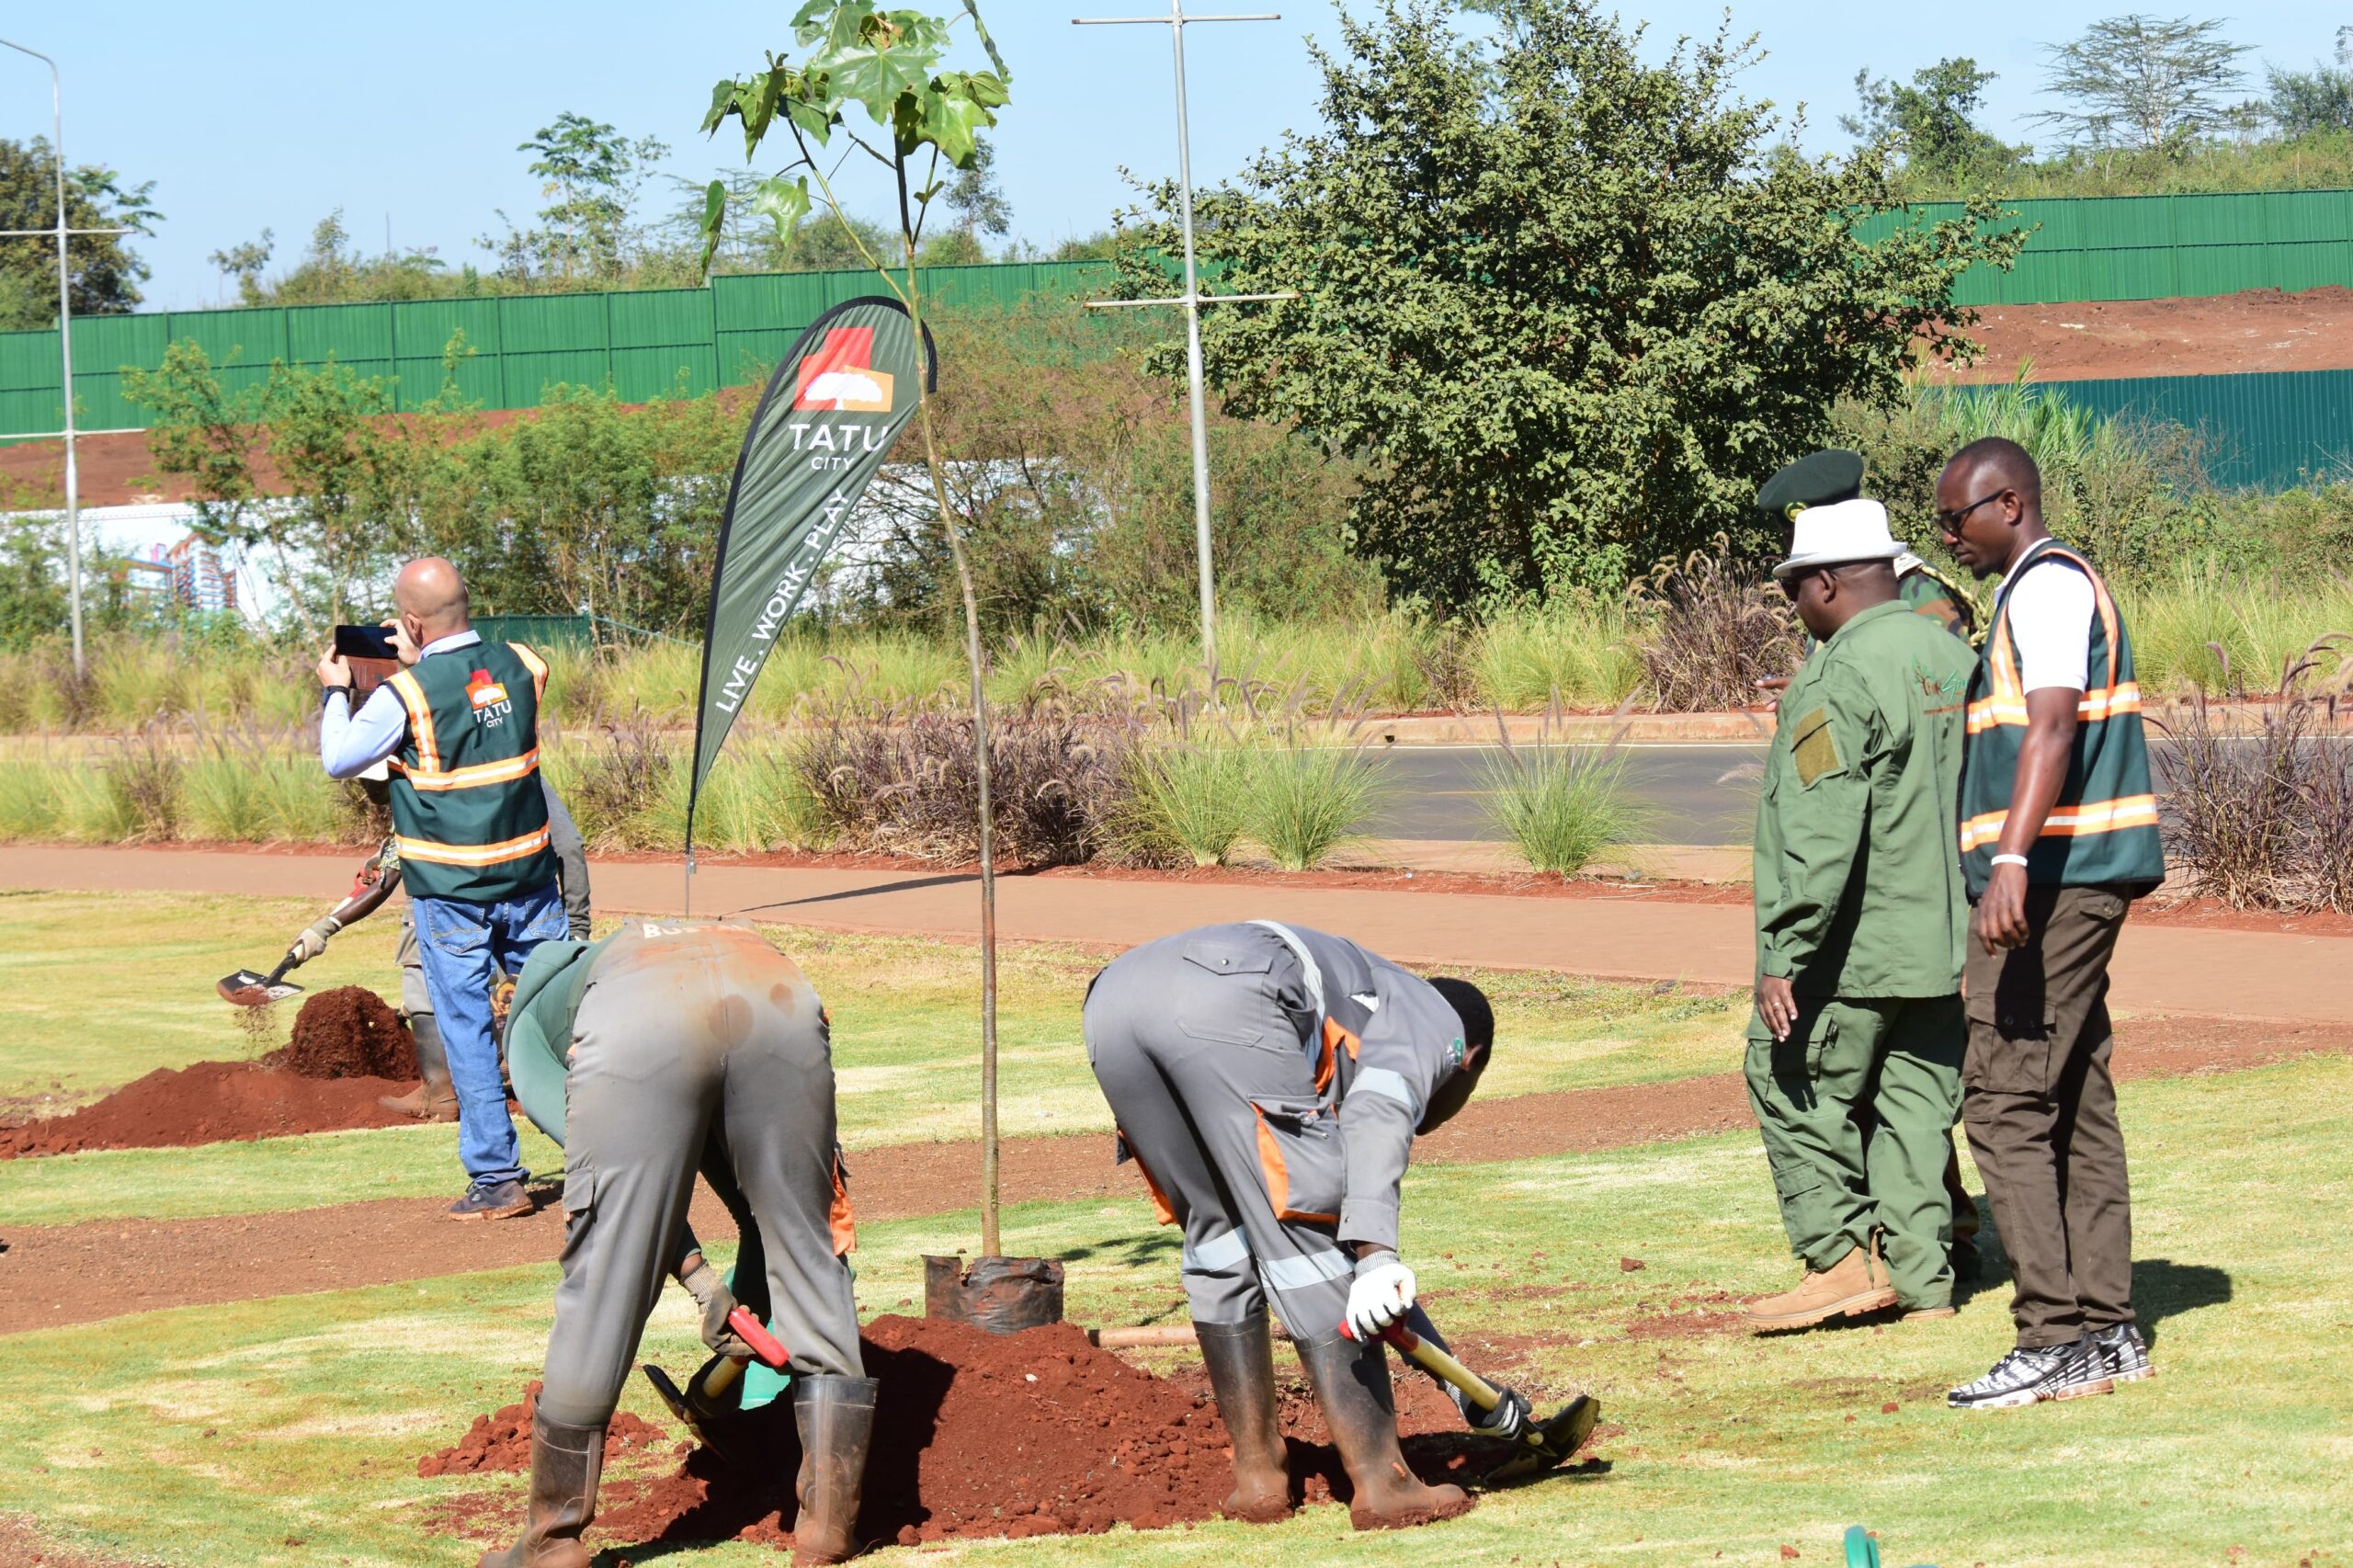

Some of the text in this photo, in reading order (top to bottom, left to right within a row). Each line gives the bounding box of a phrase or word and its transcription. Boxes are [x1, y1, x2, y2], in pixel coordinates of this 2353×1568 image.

[789, 423, 888, 452] TATU
[811, 456, 855, 471] CITY
[715, 654, 757, 713] LIVE
[751, 561, 808, 641] WORK
[803, 487, 848, 551] PLAY
[473, 699, 512, 723] TATU
[486, 717, 503, 728] CITY
